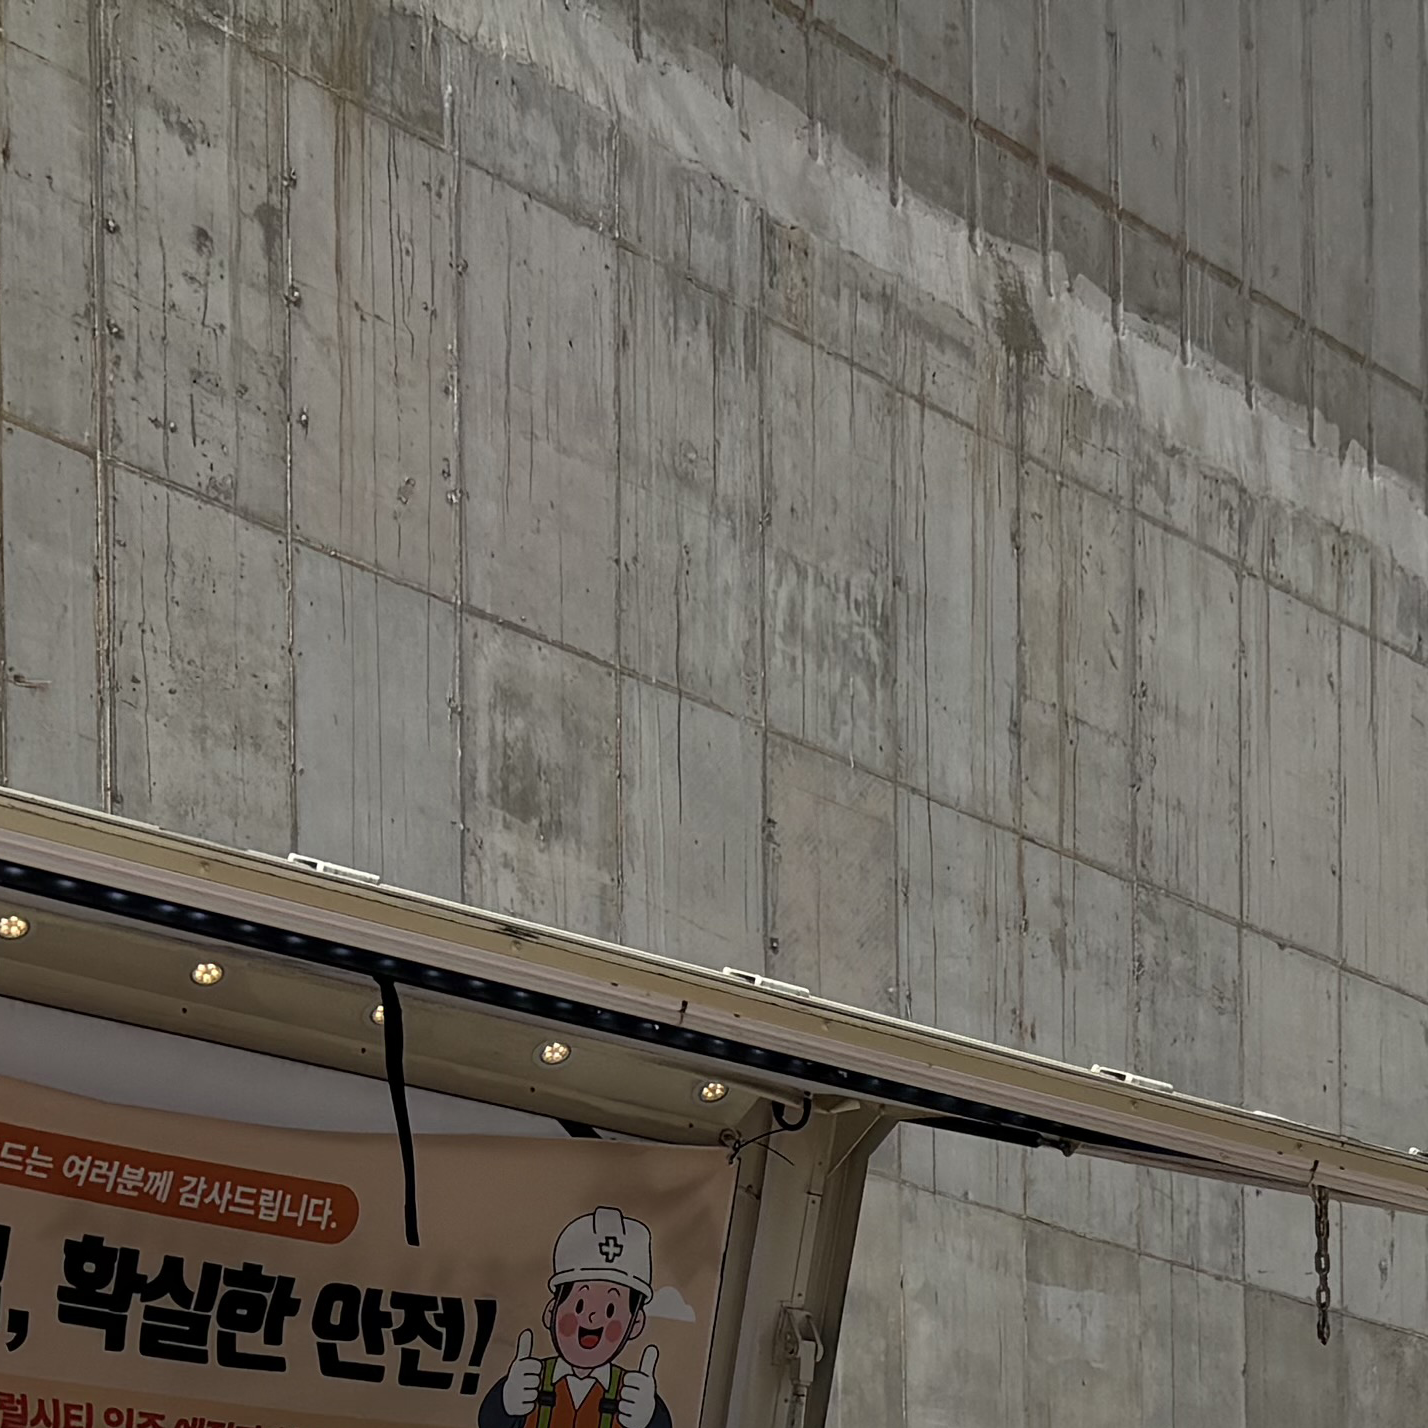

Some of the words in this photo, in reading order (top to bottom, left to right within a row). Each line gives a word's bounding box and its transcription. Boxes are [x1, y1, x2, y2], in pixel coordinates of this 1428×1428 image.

[62, 1154, 174, 1204] 여러분께
[179, 1174, 339, 1231] 감사드립니다.
[57, 1233, 302, 1373] 확실한
[311, 1282, 498, 1396] 안전!
